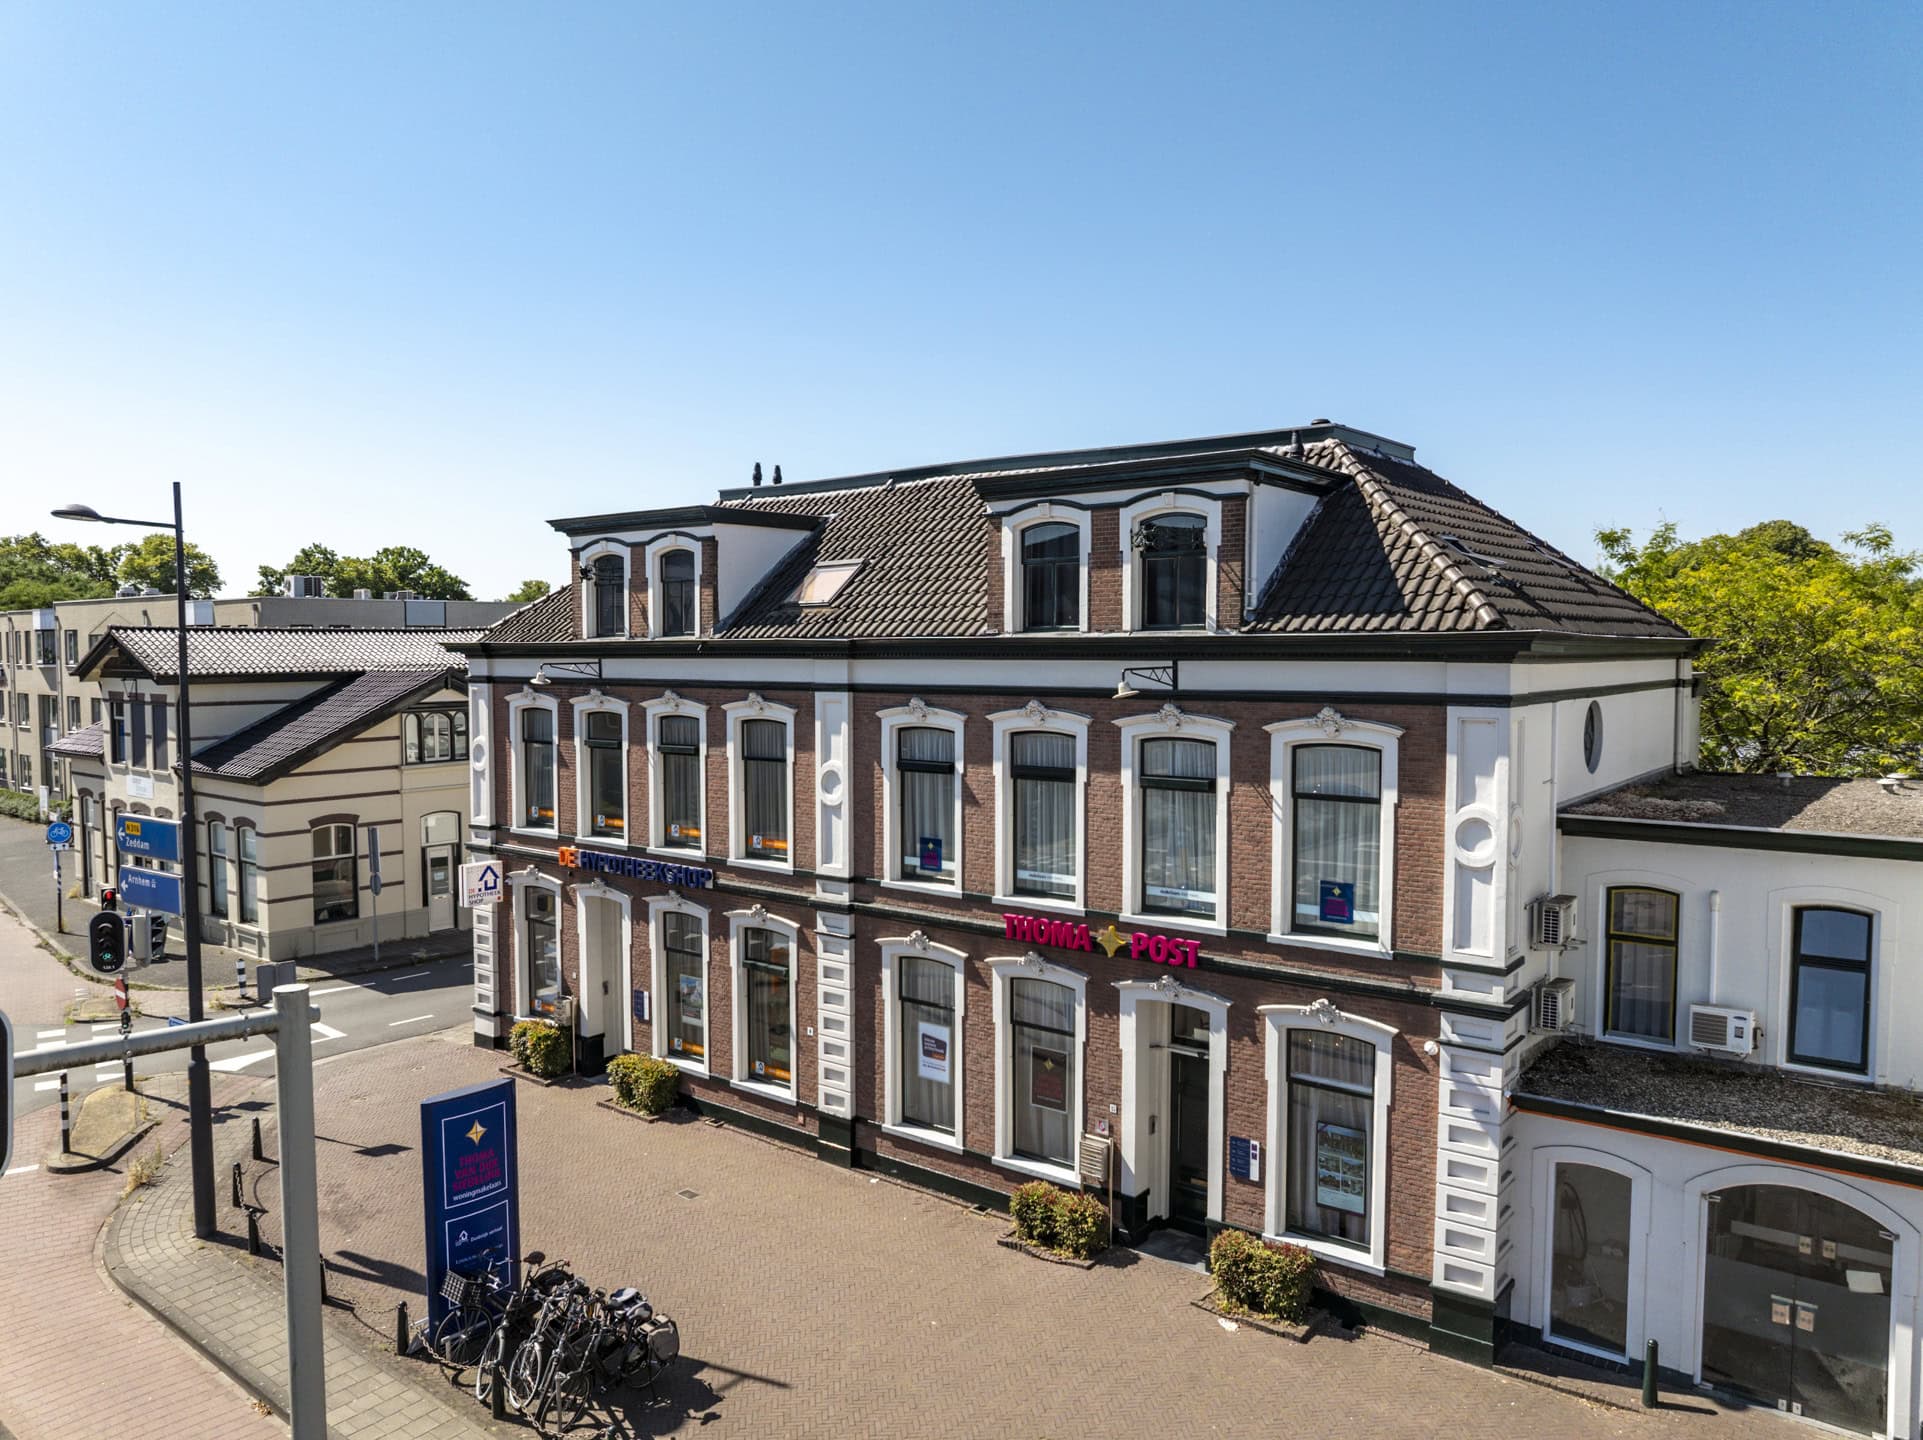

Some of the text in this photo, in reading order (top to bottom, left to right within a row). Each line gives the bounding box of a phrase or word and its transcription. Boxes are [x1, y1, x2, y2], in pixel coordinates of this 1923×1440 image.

[125, 836, 150, 850] Zeddam
[558, 847, 712, 889] DE HYPOTHEEKSHOP
[128, 874, 151, 887] Arnhem
[1003, 913, 1201, 969] THOMA POST
[458, 1148, 495, 1167] THOMA
[455, 1166, 477, 1180] VAN
[453, 1180, 502, 1201] woningmakelaars
